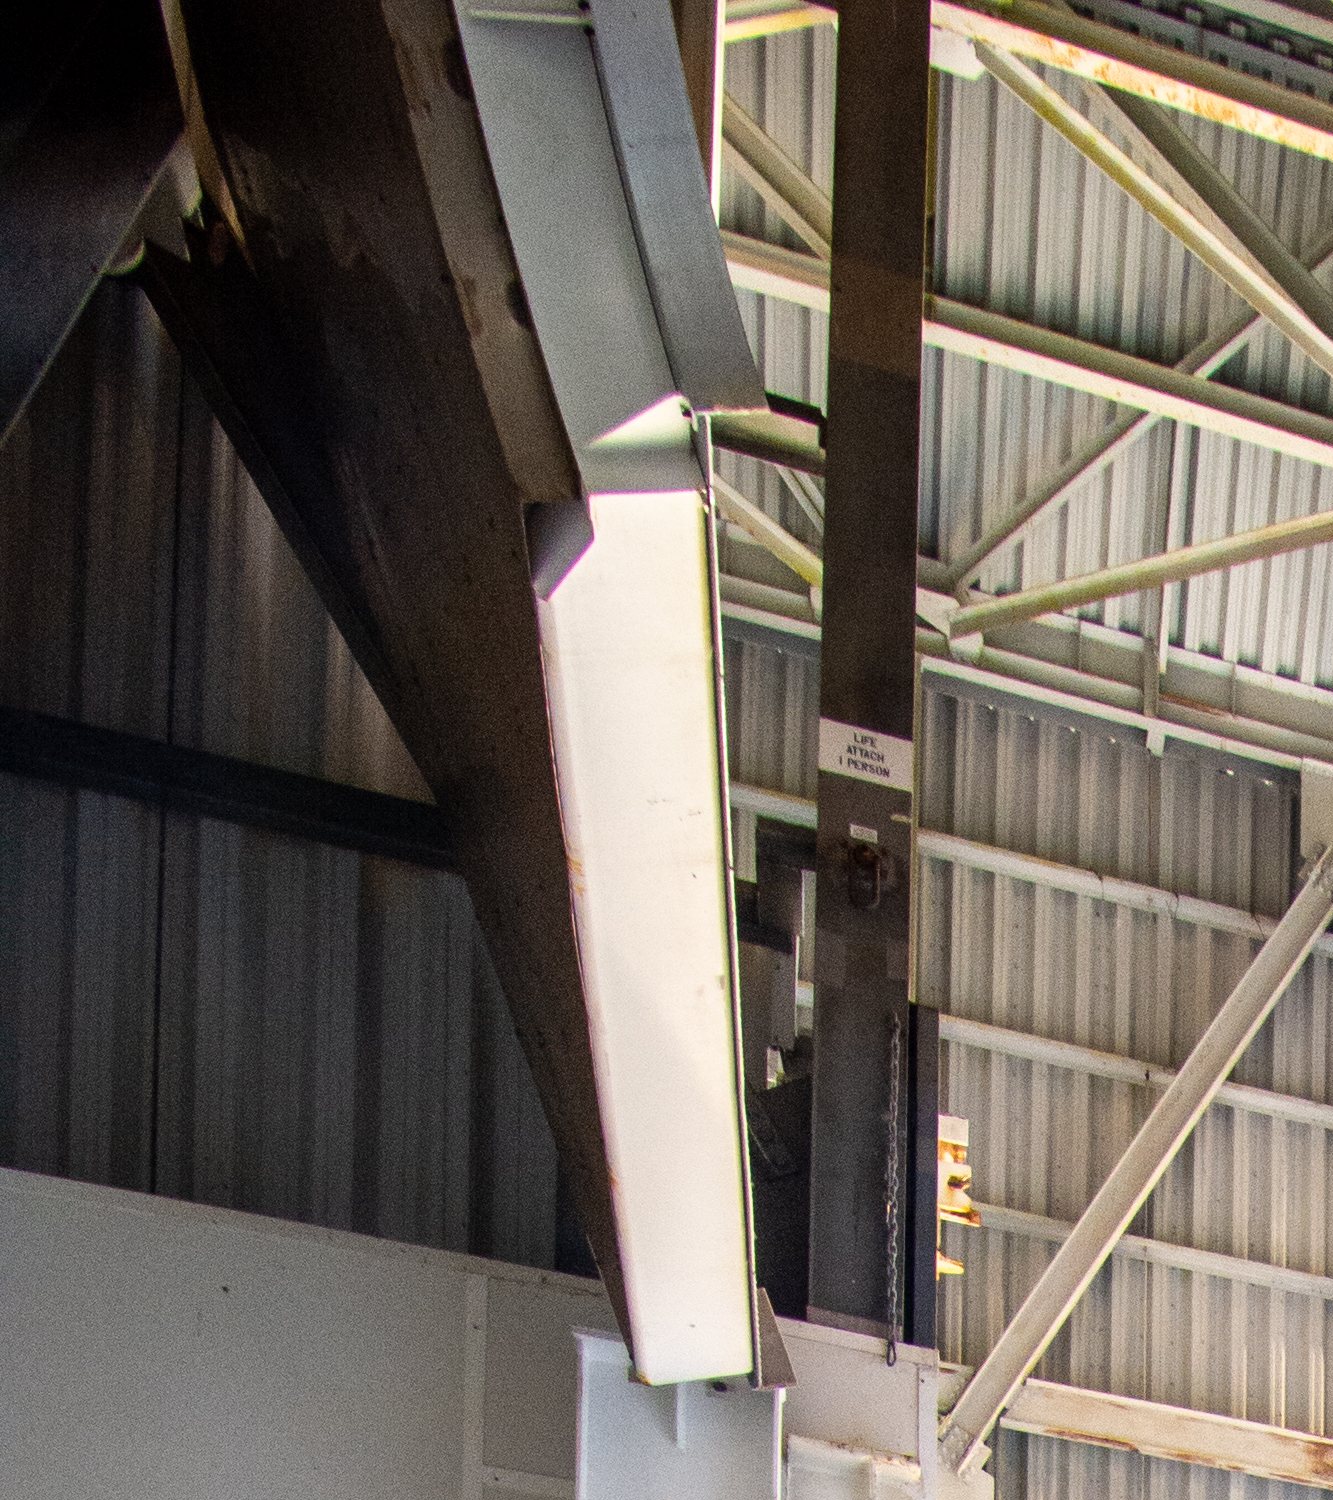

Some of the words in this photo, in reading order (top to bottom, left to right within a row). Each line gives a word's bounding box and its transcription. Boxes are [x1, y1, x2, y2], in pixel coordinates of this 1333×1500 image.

[853, 731, 877, 748] LIFE
[846, 744, 885, 764] ATTACH
[847, 757, 890, 778] PERSON
